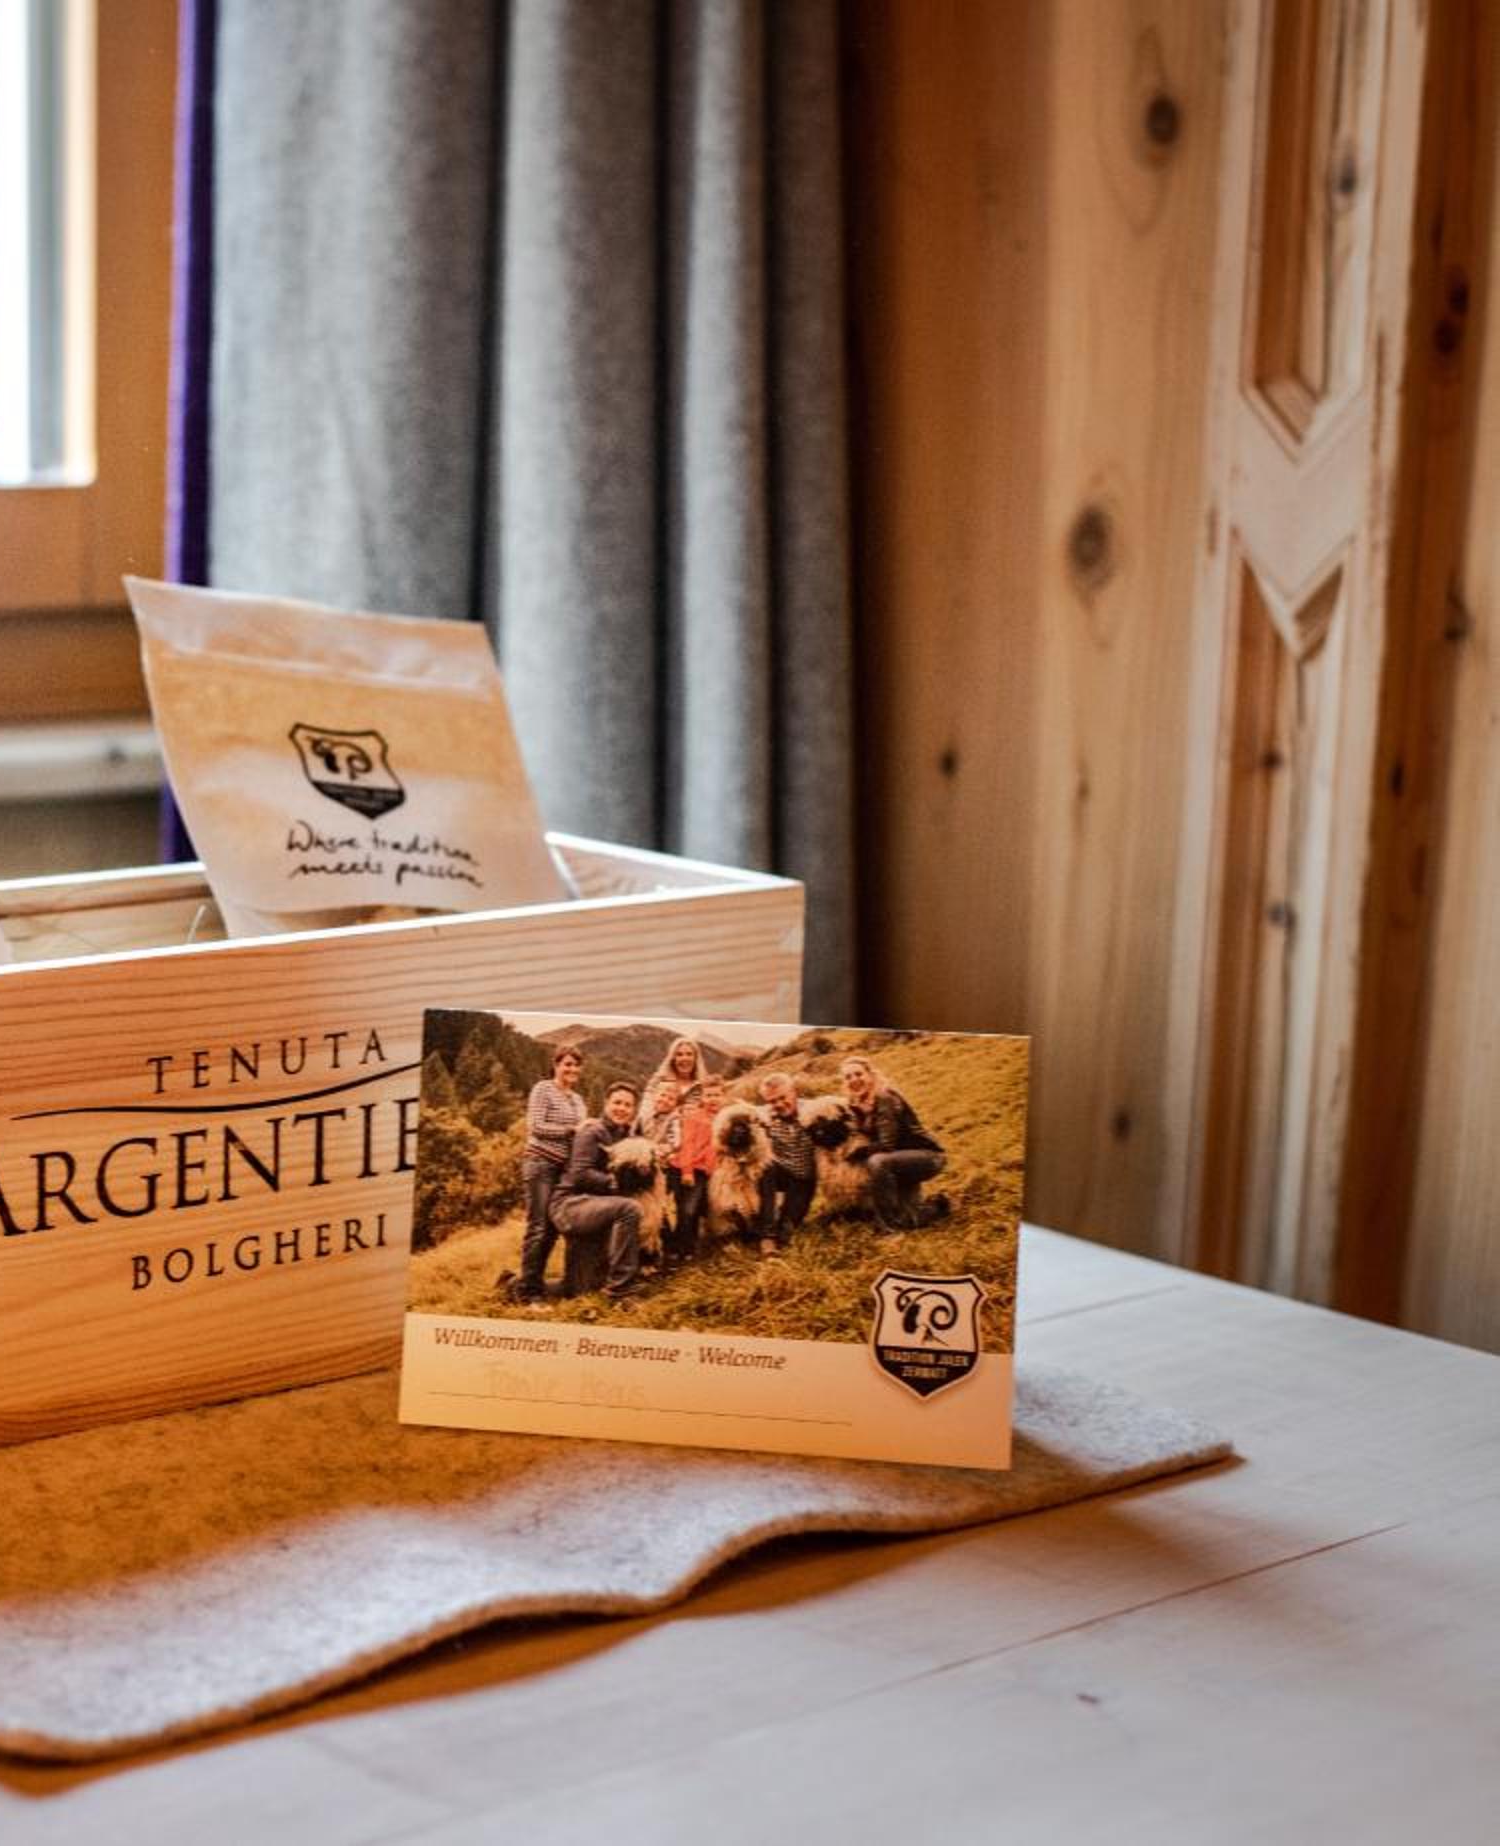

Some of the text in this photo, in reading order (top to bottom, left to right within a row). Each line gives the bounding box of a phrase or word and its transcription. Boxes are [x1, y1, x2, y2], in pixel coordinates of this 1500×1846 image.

[286, 820, 480, 866] Where tradition
[288, 853, 484, 888] meets passion
[147, 1028, 388, 1094] TENUTA
[131, 1213, 388, 1291] BOLGHERI
[434, 1327, 787, 1371] Willkommen Bienvenue Welcome
